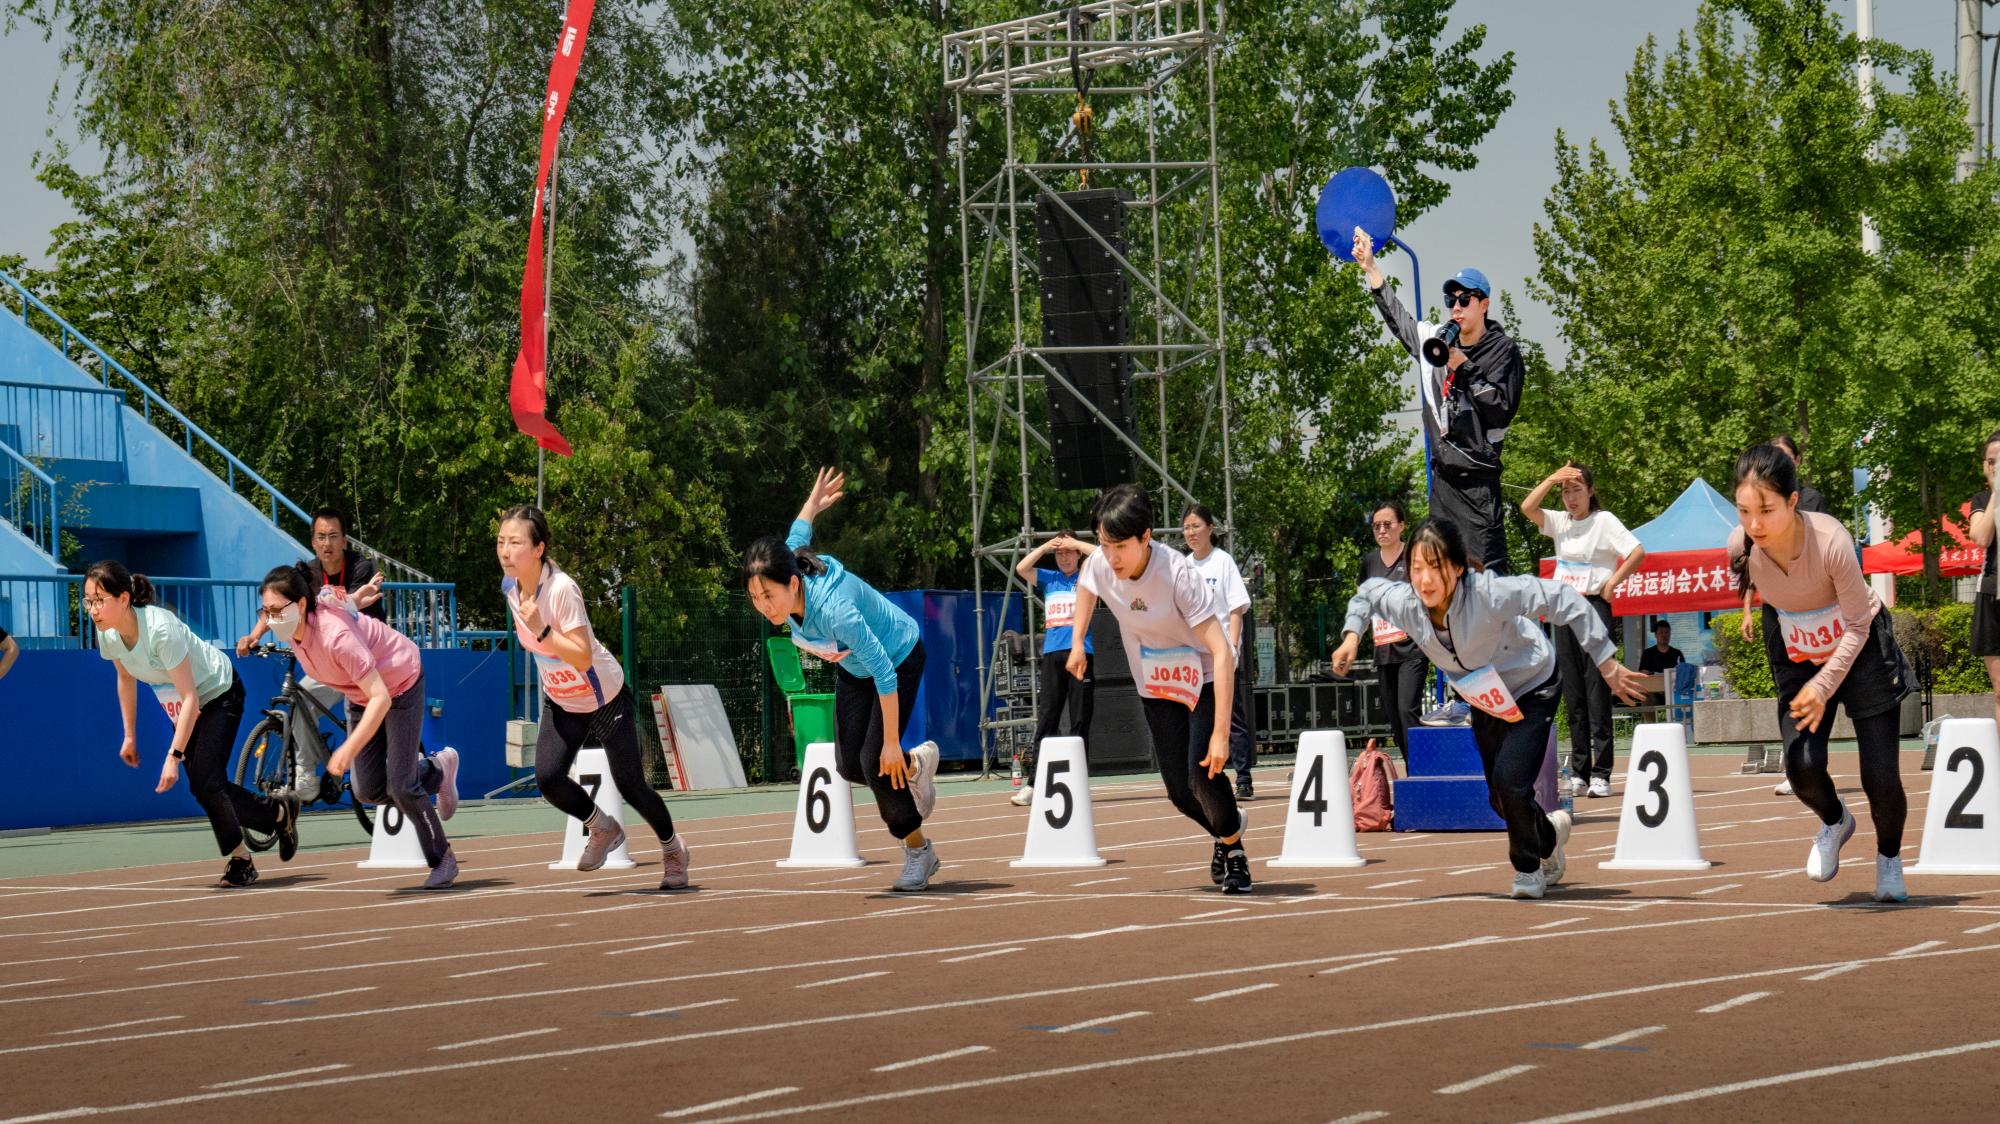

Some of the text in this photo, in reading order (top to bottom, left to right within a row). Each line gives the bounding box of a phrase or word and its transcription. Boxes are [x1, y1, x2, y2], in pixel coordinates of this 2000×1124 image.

[1150, 665, 1200, 688] J0436
[579, 773, 602, 837] 7
[805, 766, 832, 834] 6
[1044, 759, 1073, 829] 5
[1297, 755, 1328, 827] 4
[1635, 750, 1669, 828] 3
[1944, 746, 1984, 829] 2
